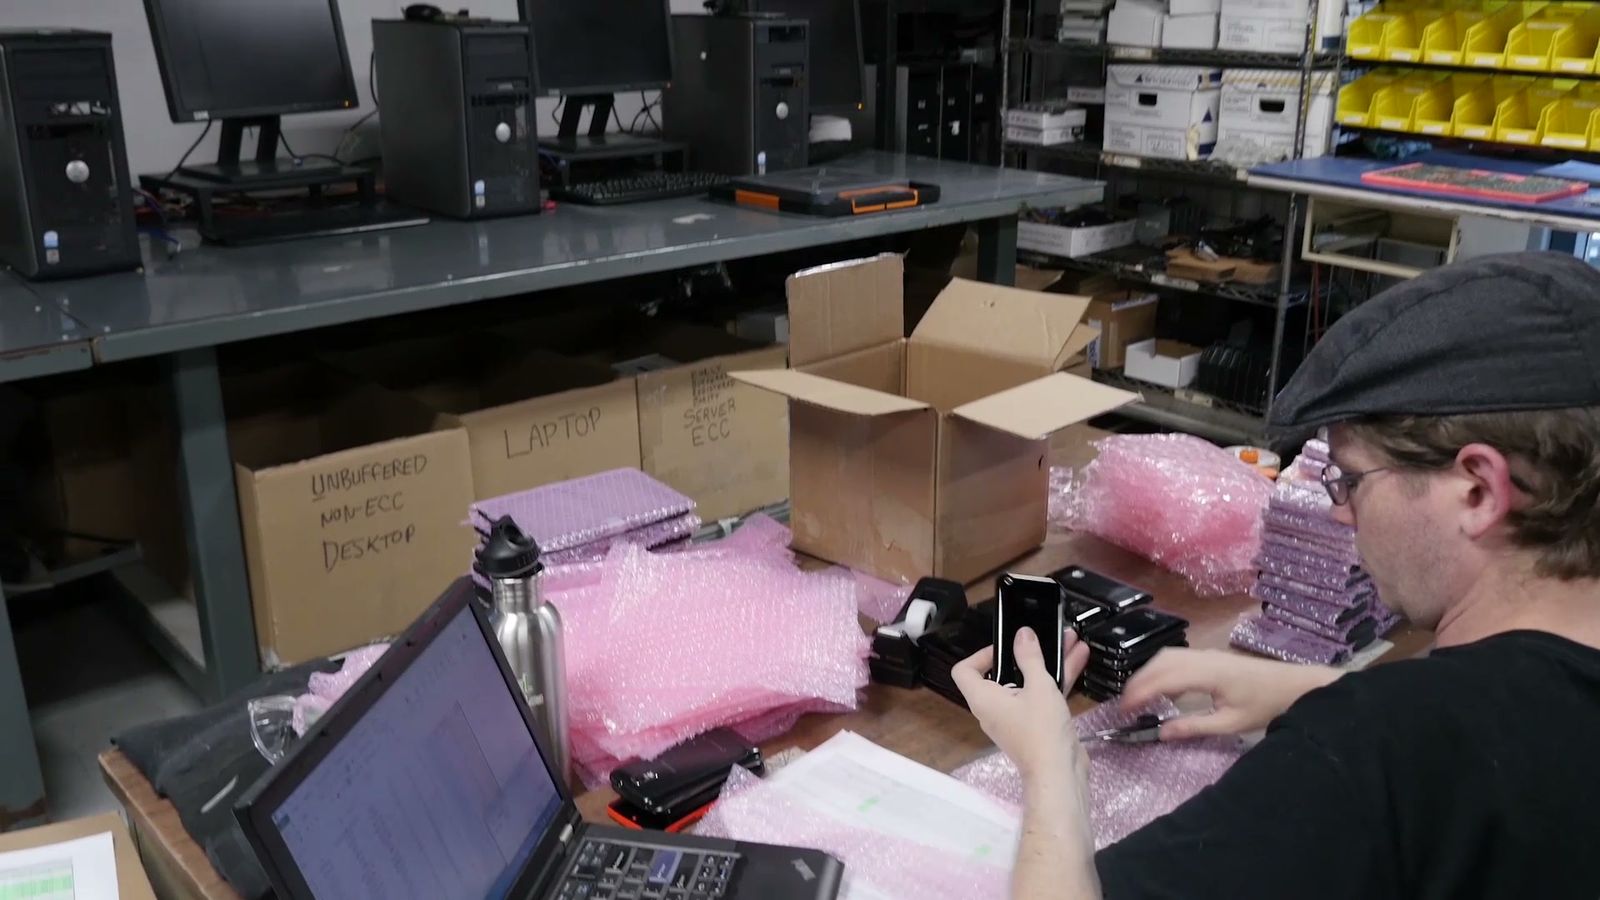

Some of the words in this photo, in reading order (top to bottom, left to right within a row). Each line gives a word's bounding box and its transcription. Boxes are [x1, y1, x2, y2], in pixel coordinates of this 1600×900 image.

[504, 406, 601, 459] LAPTOP
[683, 397, 737, 429] SERVER
[691, 418, 731, 447] ECC
[311, 454, 428, 497] UNBUFFERED
[320, 491, 404, 528] NON-ECC
[322, 522, 416, 574] DESKTOP
